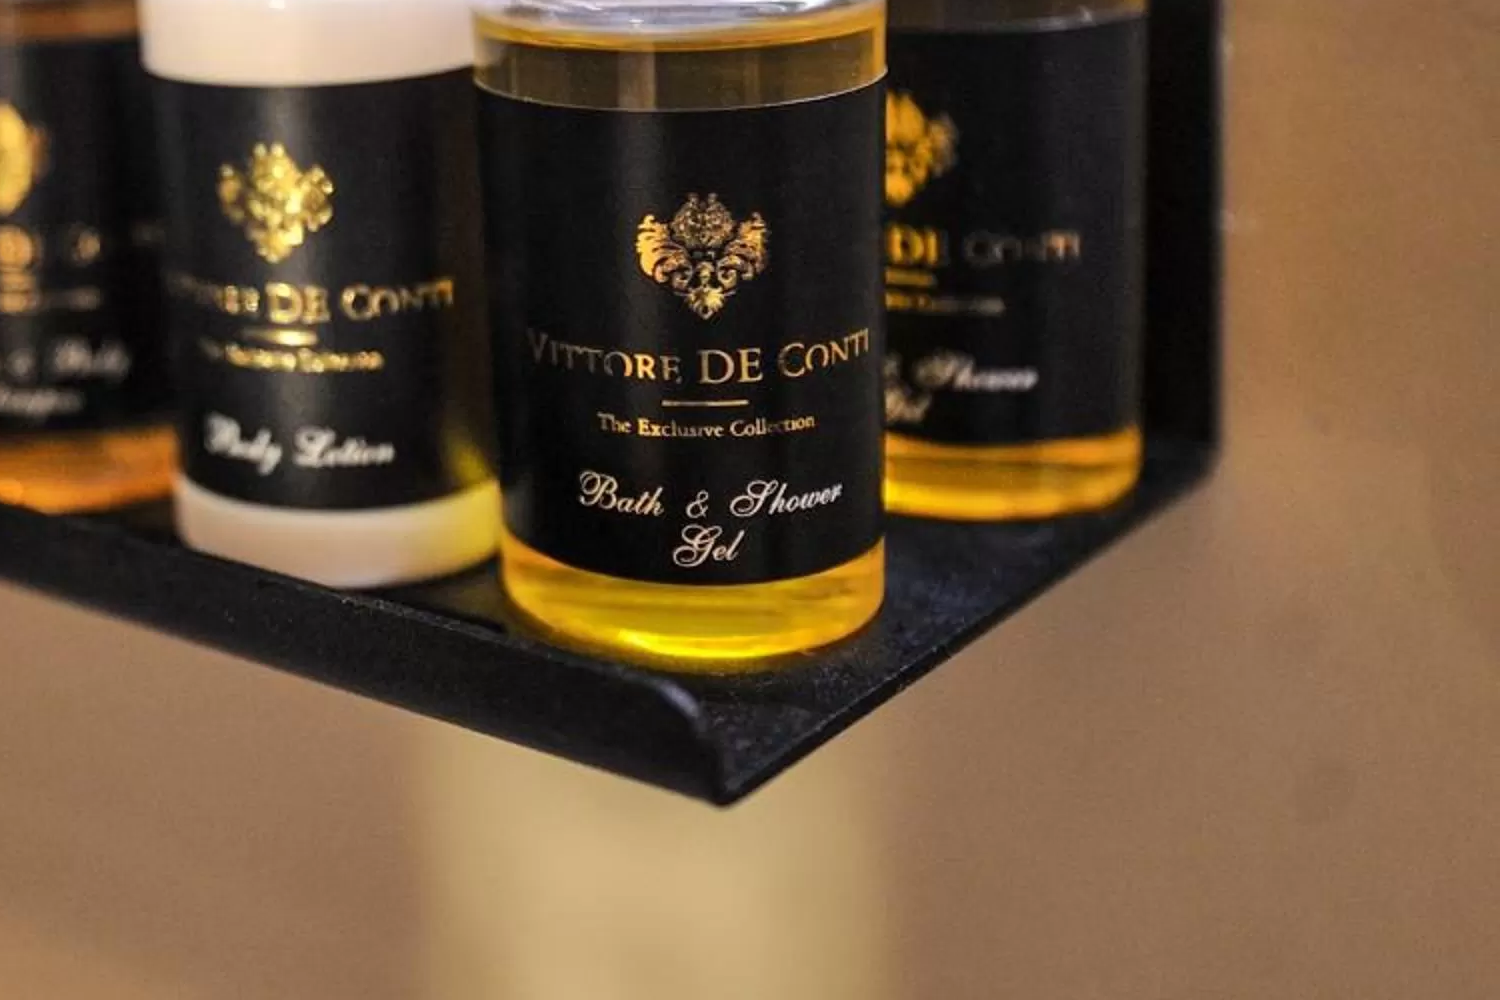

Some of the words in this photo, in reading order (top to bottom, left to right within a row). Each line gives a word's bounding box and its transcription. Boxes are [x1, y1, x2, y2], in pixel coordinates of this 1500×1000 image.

[526, 328, 682, 383] VITTORE
[699, 347, 763, 385] DE
[597, 412, 631, 435] The
[638, 418, 724, 438] Exclusive
[729, 414, 816, 437] Collection
[579, 469, 665, 518] Bath
[685, 490, 709, 519] &
[729, 479, 844, 518] Shower
[672, 524, 746, 568] Gel
